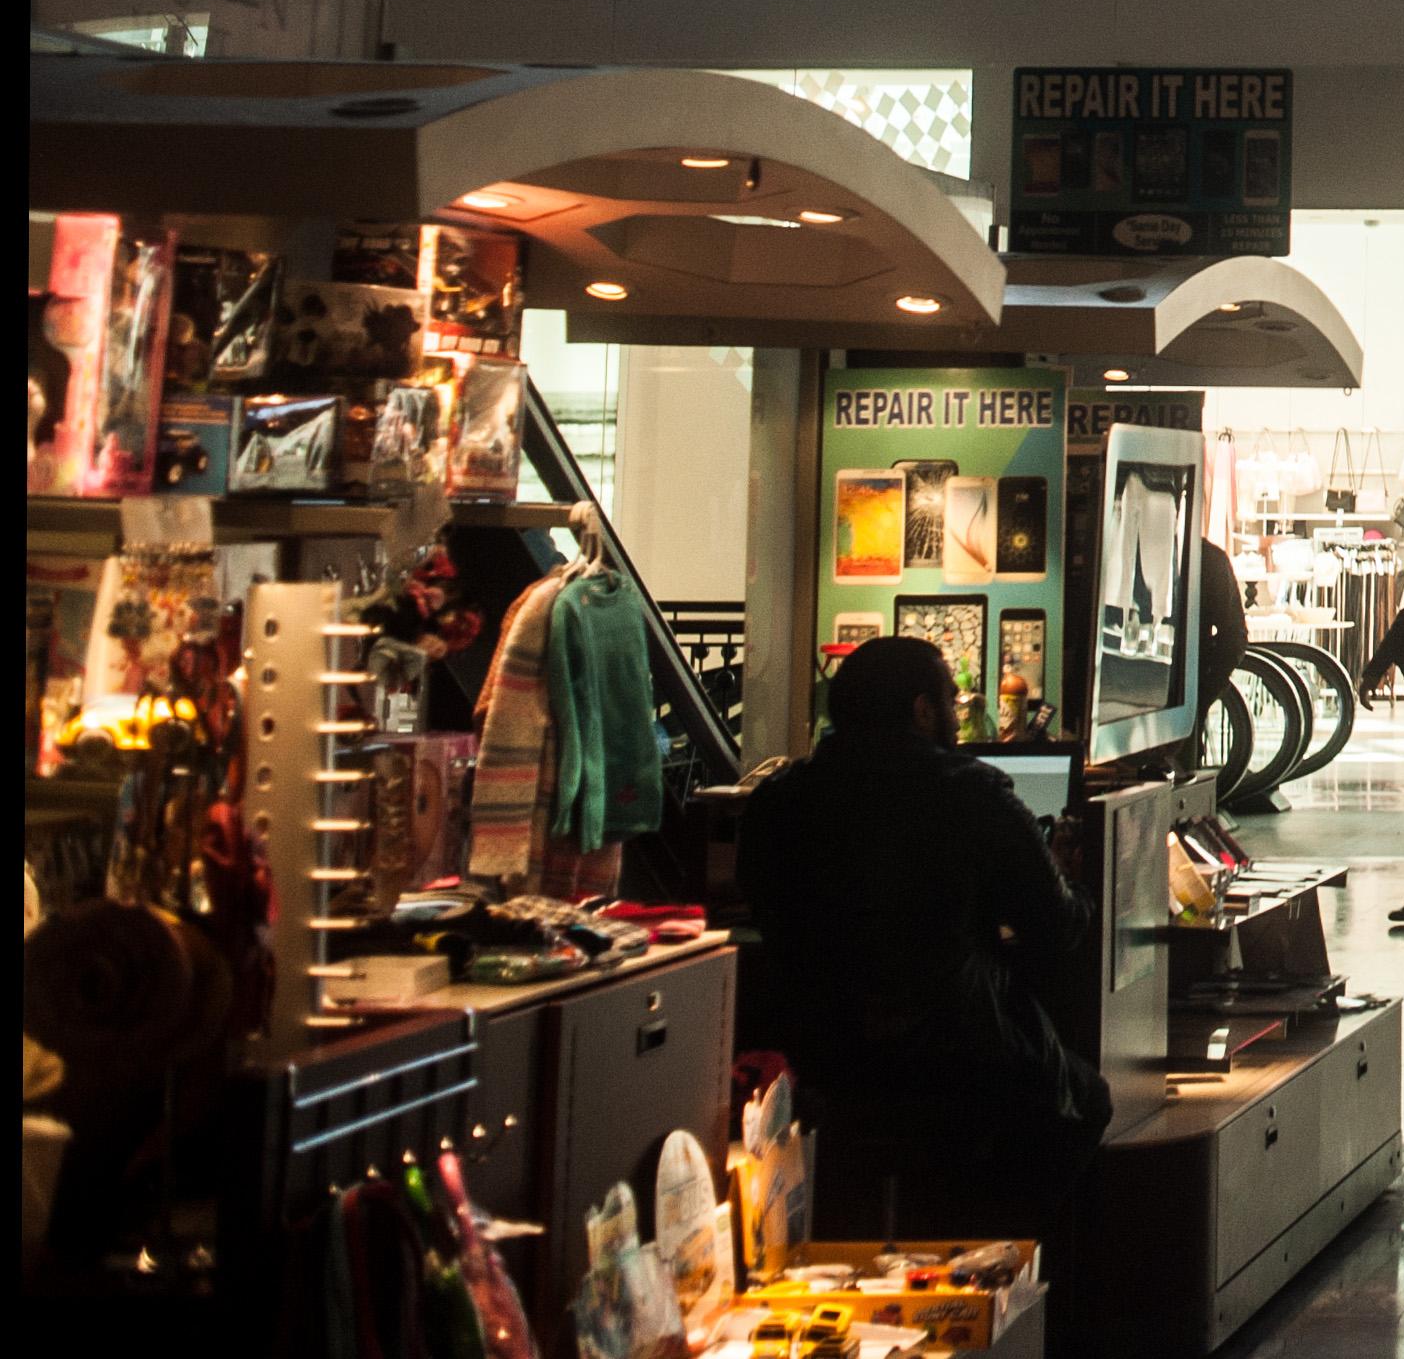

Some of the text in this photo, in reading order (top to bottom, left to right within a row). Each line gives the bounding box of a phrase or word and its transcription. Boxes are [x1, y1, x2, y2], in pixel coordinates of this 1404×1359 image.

[1019, 74, 1286, 120] REPAIR IT HERE
[834, 389, 1053, 427] REPAIR IT HERE
[1068, 403, 1190, 435] REPAIR
